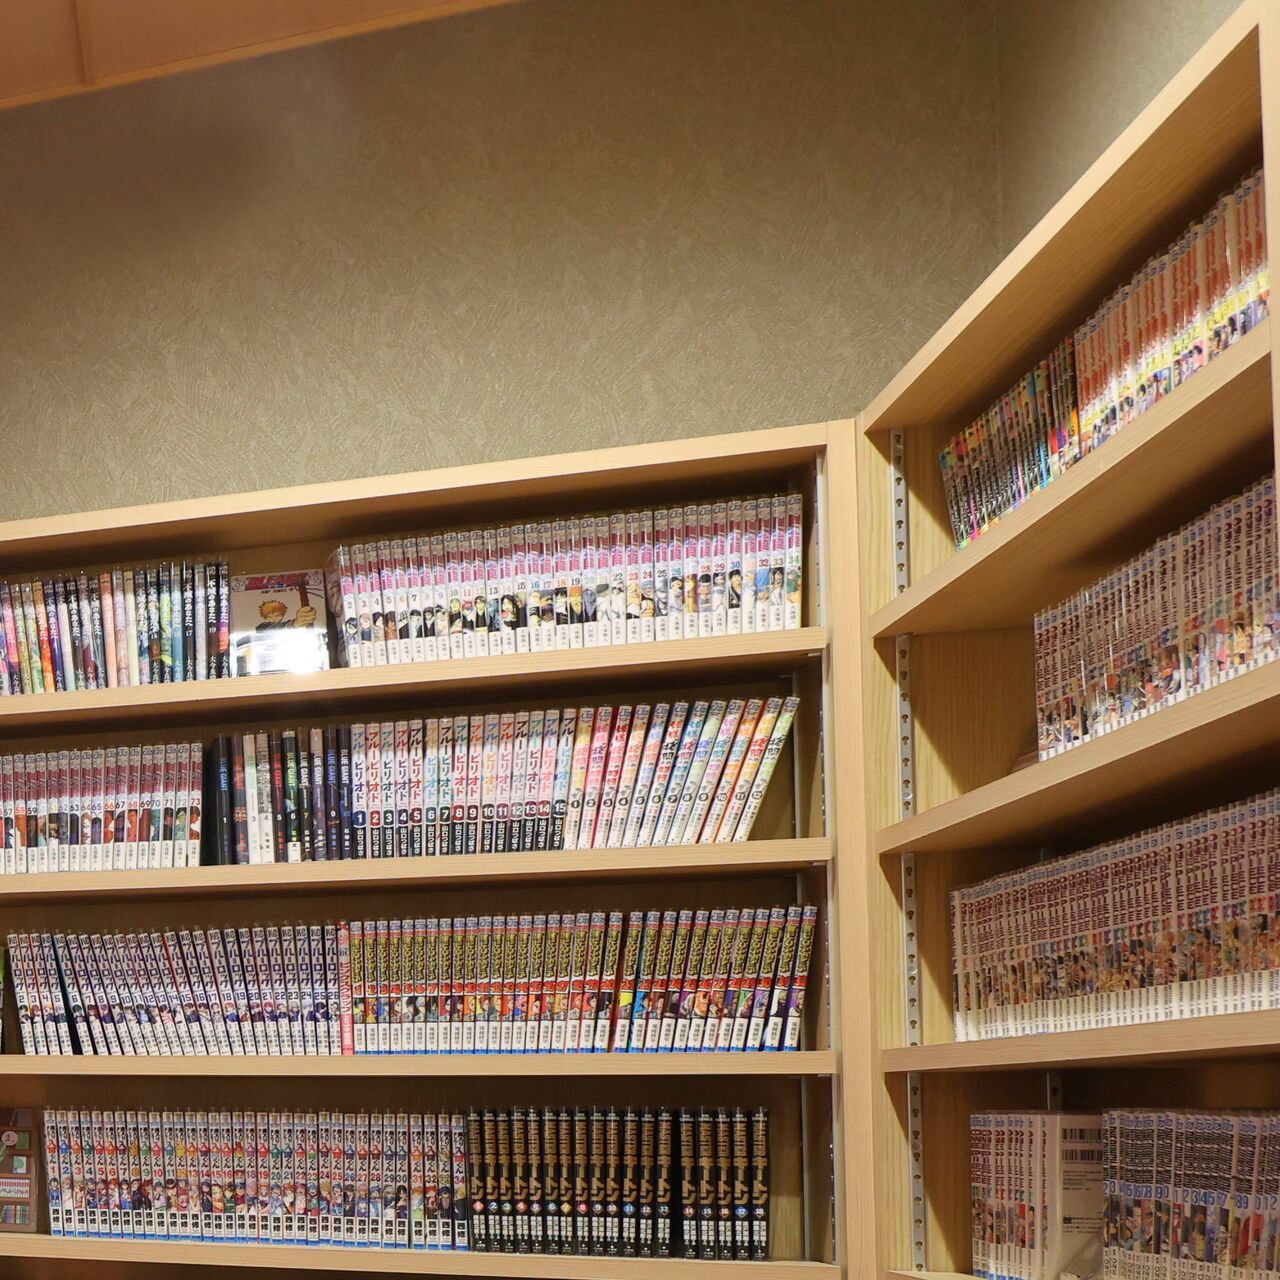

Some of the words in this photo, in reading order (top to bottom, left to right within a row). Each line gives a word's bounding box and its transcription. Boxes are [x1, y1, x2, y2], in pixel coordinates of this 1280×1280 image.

[525, 804, 536, 813] 13
[554, 803, 565, 812] 15
[400, 812, 406, 820] 4
[414, 811, 420, 819] 5
[442, 810, 448, 818] 7
[456, 808, 462, 817] 8
[470, 809, 476, 817] 9
[372, 814, 379, 825] 2
[386, 813, 392, 821] 3
[19, 995, 25, 1003] 2
[63, 1167, 69, 1175] 2
[153, 1169, 162, 1177] 10
[201, 1170, 210, 1178] 14
[454, 1176, 465, 1184] 34
